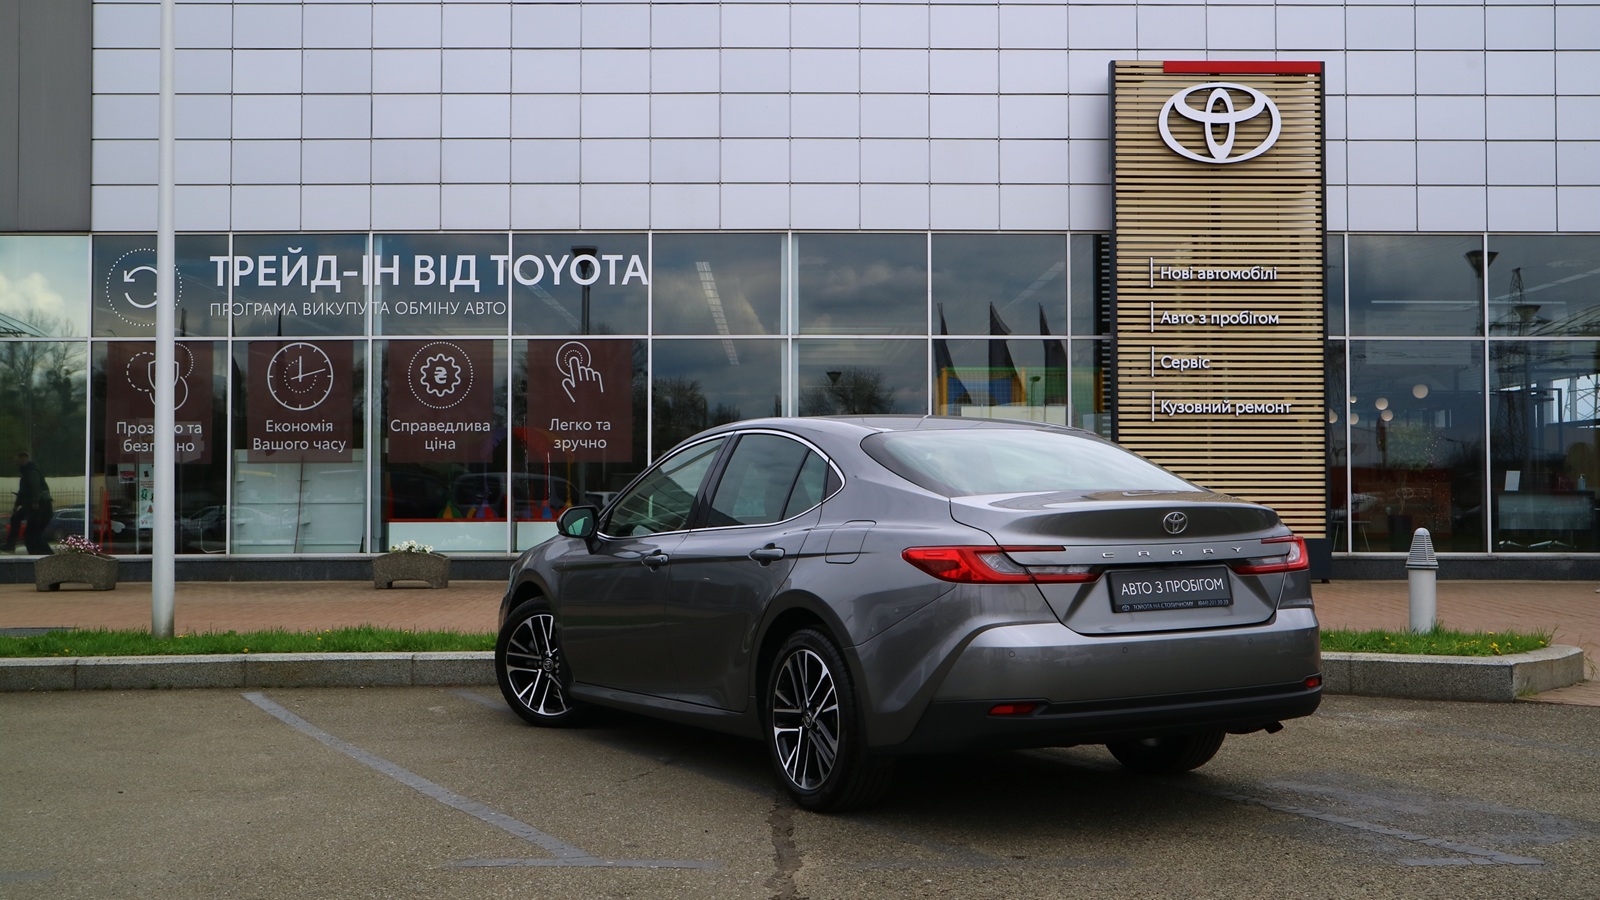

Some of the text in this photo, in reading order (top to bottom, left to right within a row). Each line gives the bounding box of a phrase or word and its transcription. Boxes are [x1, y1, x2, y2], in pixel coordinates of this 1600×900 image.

[209, 246, 649, 293] ТРЕЙД-ІН ВІД TOYOTA
[1160, 266, 1277, 280] Нові автомобілі
[210, 301, 506, 316] ПРОГРАМА ВИКУПУ ТА ОБМІНУ АВТО
[1160, 311, 1280, 327] Авто з пробігом
[1160, 355, 1211, 372] Сервіс
[1160, 400, 1292, 417] Кузовний ремонт
[116, 421, 202, 437] Прозо та
[265, 419, 333, 432] Економія
[391, 419, 491, 435] Справедлива
[549, 419, 611, 432] Легко та
[123, 438, 195, 452] безно
[253, 437, 347, 453] Вашого часу
[425, 437, 456, 452] ціна
[554, 439, 608, 453] зручно
[1102, 546, 1241, 558] CAMRY
[1121, 578, 1224, 596] АВТО З ПРОБІГОМ
